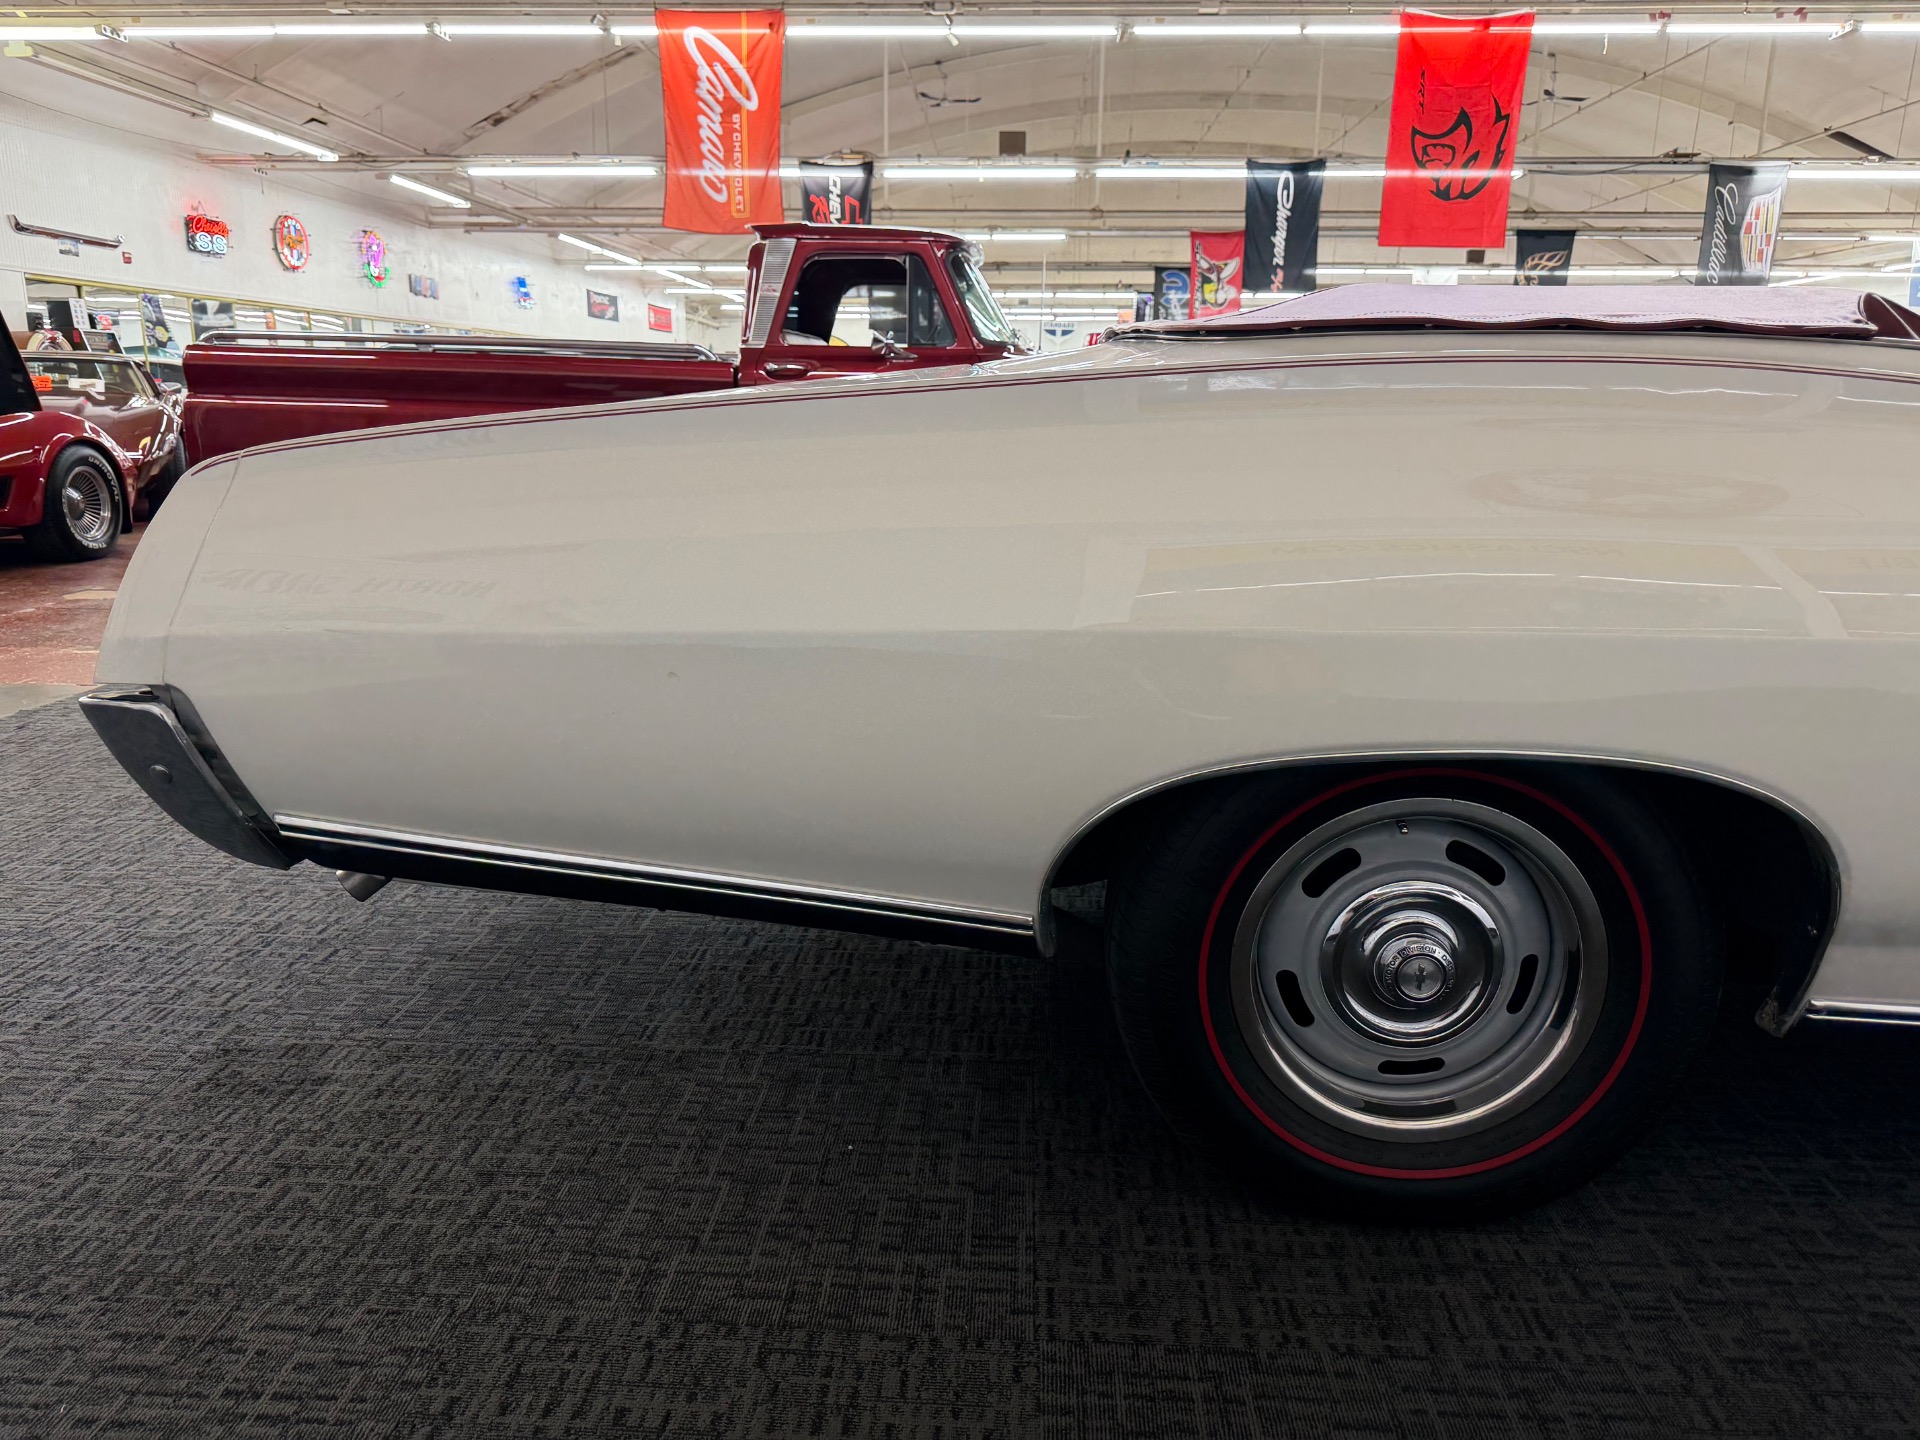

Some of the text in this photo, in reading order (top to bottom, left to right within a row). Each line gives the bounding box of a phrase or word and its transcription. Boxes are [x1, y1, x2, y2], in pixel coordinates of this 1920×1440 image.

[682, 26, 759, 203] Camaro
[731, 113, 741, 129] BY
[1270, 170, 1295, 266] Charger
[1706, 183, 1739, 284] Cadillac
[195, 232, 228, 254] SS
[88, 456, 120, 502] UNIROYAL
[1399, 944, 1437, 957] DIVISION
